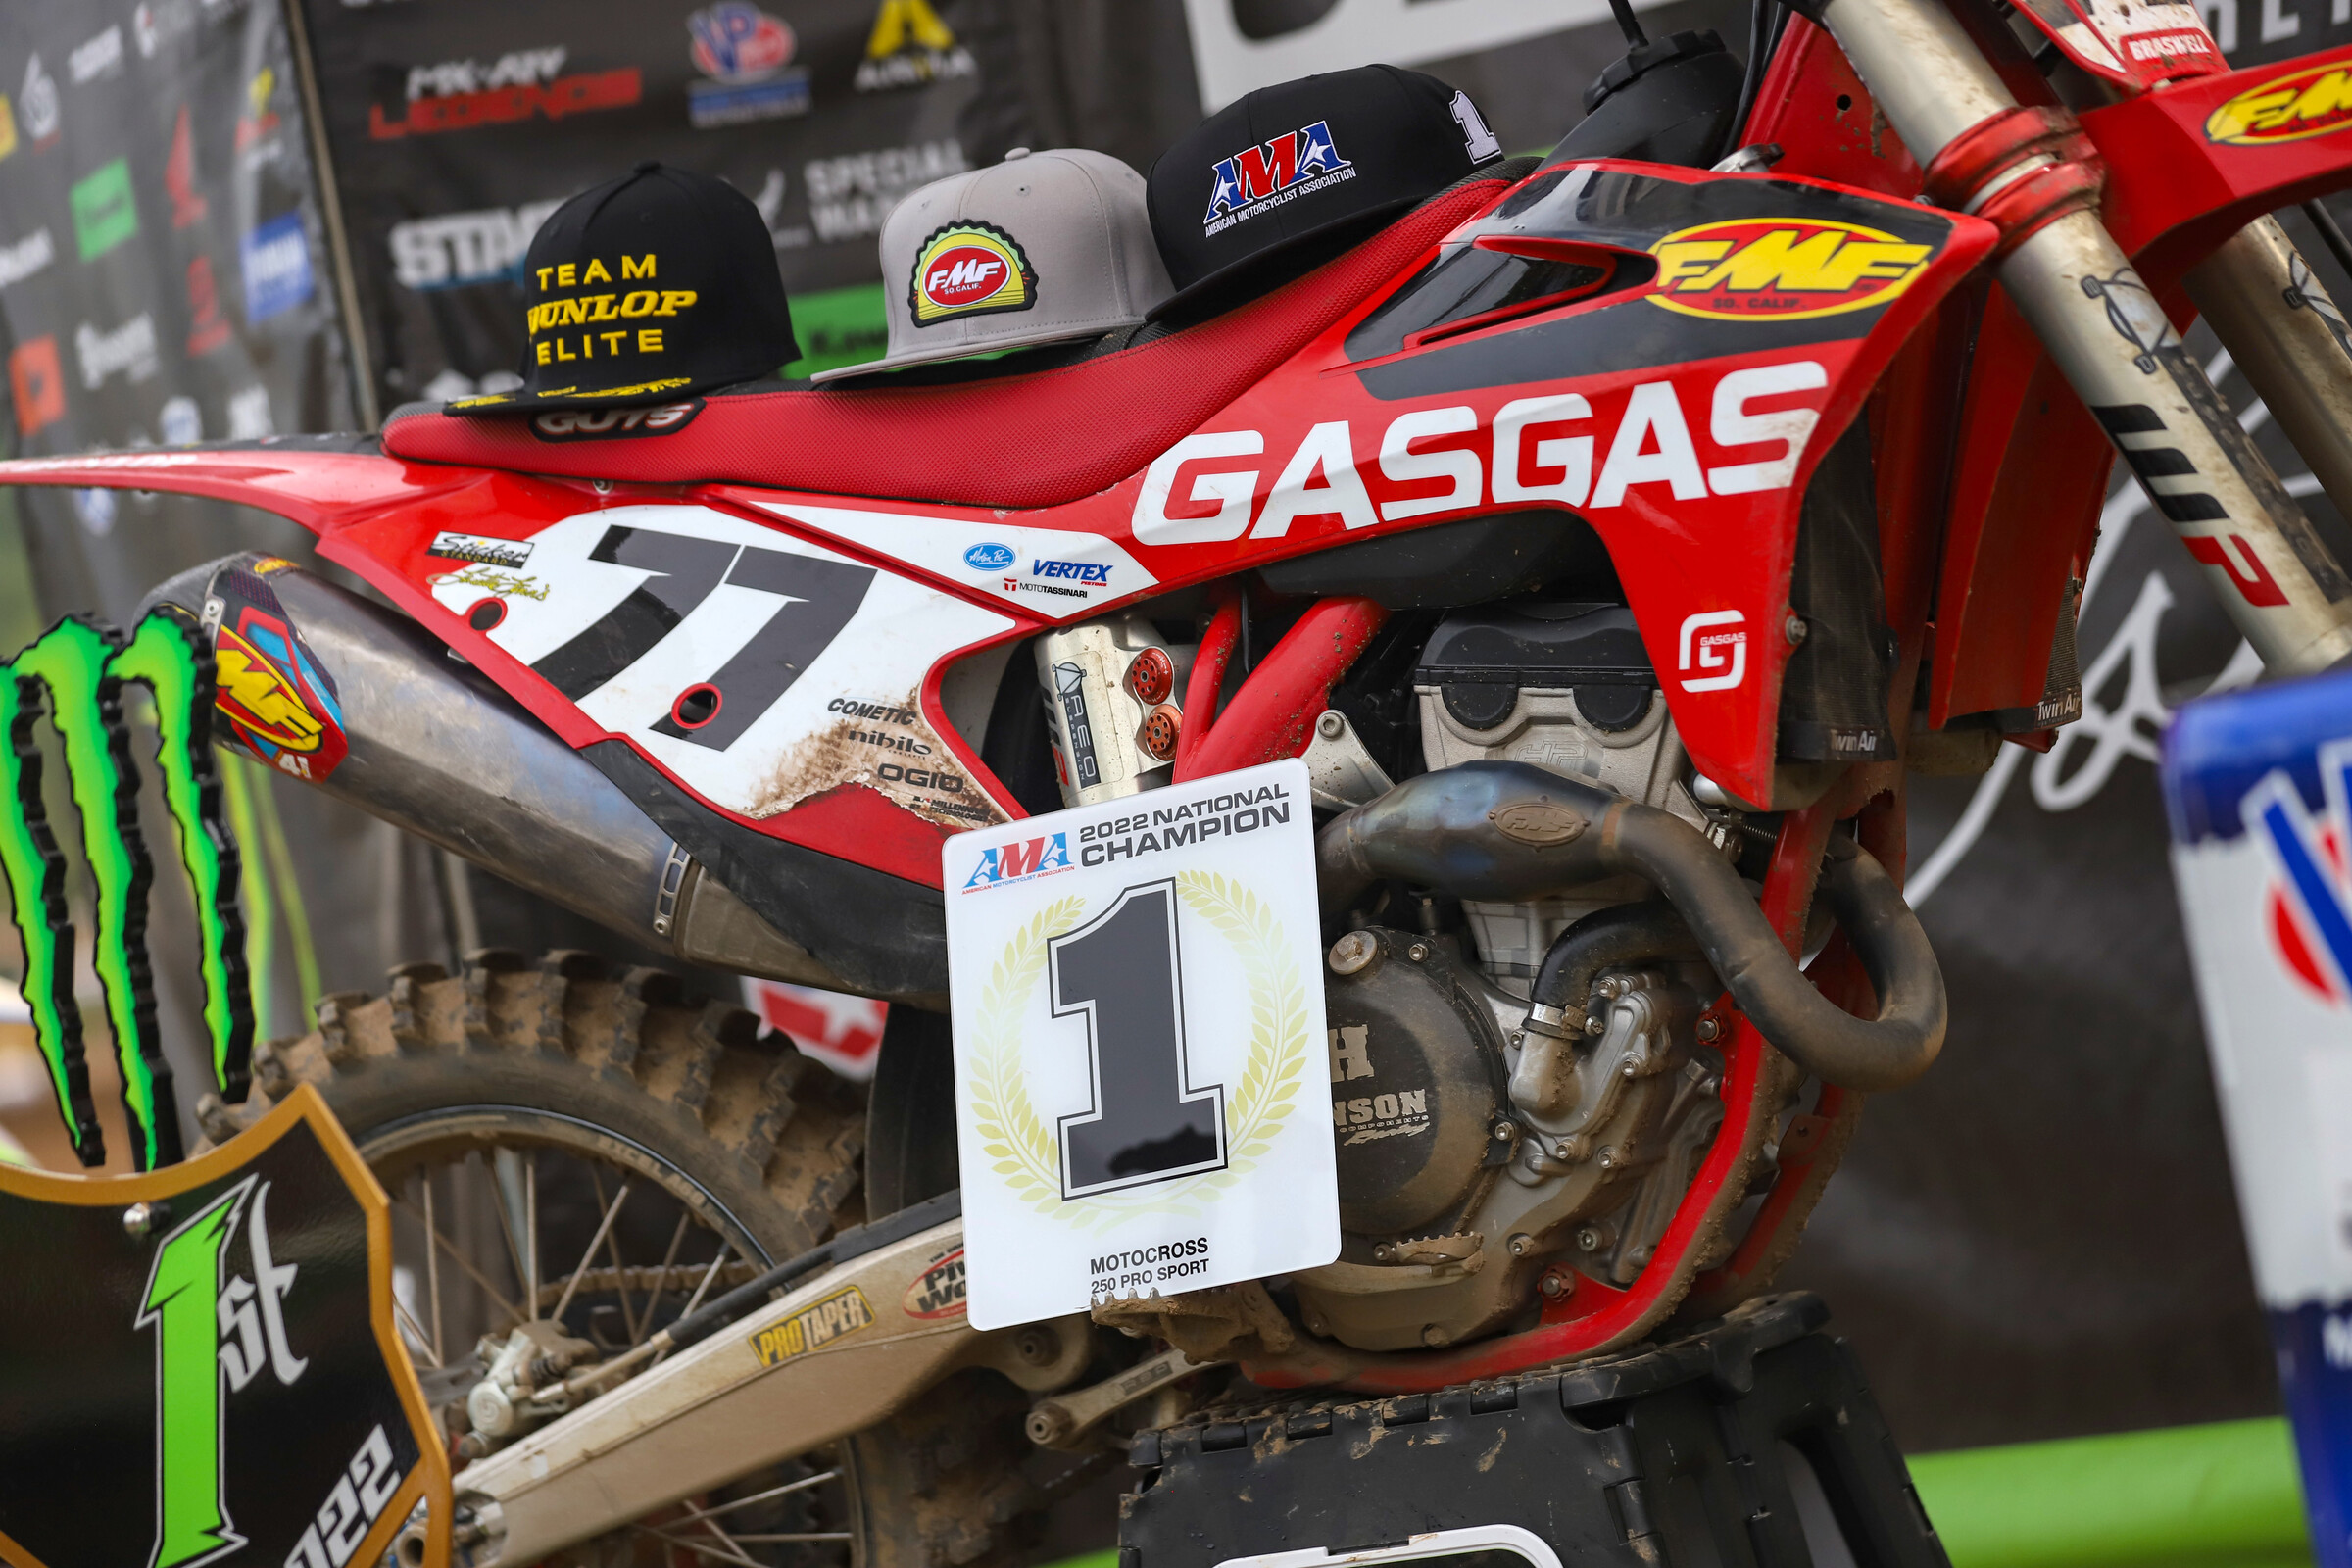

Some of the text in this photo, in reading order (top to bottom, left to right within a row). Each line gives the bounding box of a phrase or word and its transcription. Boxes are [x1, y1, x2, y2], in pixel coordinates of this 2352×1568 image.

[2128, 34, 2210, 61] BRASWELL
[2208, 69, 2352, 141] FM
[1449, 90, 1501, 165] 1
[1203, 120, 1352, 224] AMA
[1205, 167, 1357, 238] AMERICAN MOTORCYCLIST ASSOCIATION
[536, 254, 657, 291] TEAM
[928, 258, 1002, 292] FMF
[1656, 228, 1934, 293] FMF
[536, 329, 664, 366] ELITE
[537, 403, 693, 434] GUTS
[1132, 360, 1828, 547] GASGAS
[1032, 559, 1114, 582] VERTEX
[1018, 582, 1089, 599] MOTOTASSINARI
[528, 524, 879, 753] 77
[1700, 631, 1748, 647] GASGAS
[827, 698, 917, 726] COMETIC
[2037, 700, 2063, 722] Twin
[2065, 692, 2082, 714] Air
[1831, 729, 1878, 752] Twin Air
[877, 762, 964, 794] OGIO
[1080, 783, 1291, 843] 2022 NATIONAL
[1081, 801, 1291, 868] CHAMPION
[962, 832, 1075, 889] AMA
[961, 865, 1075, 896] AMERICAN MOTORCYCLIST ASSOCIATION
[1046, 877, 1229, 1202] 1
[1090, 1237, 1209, 1275] MOTOCROSS
[1091, 1258, 1210, 1295] 250 PRO SPORT
